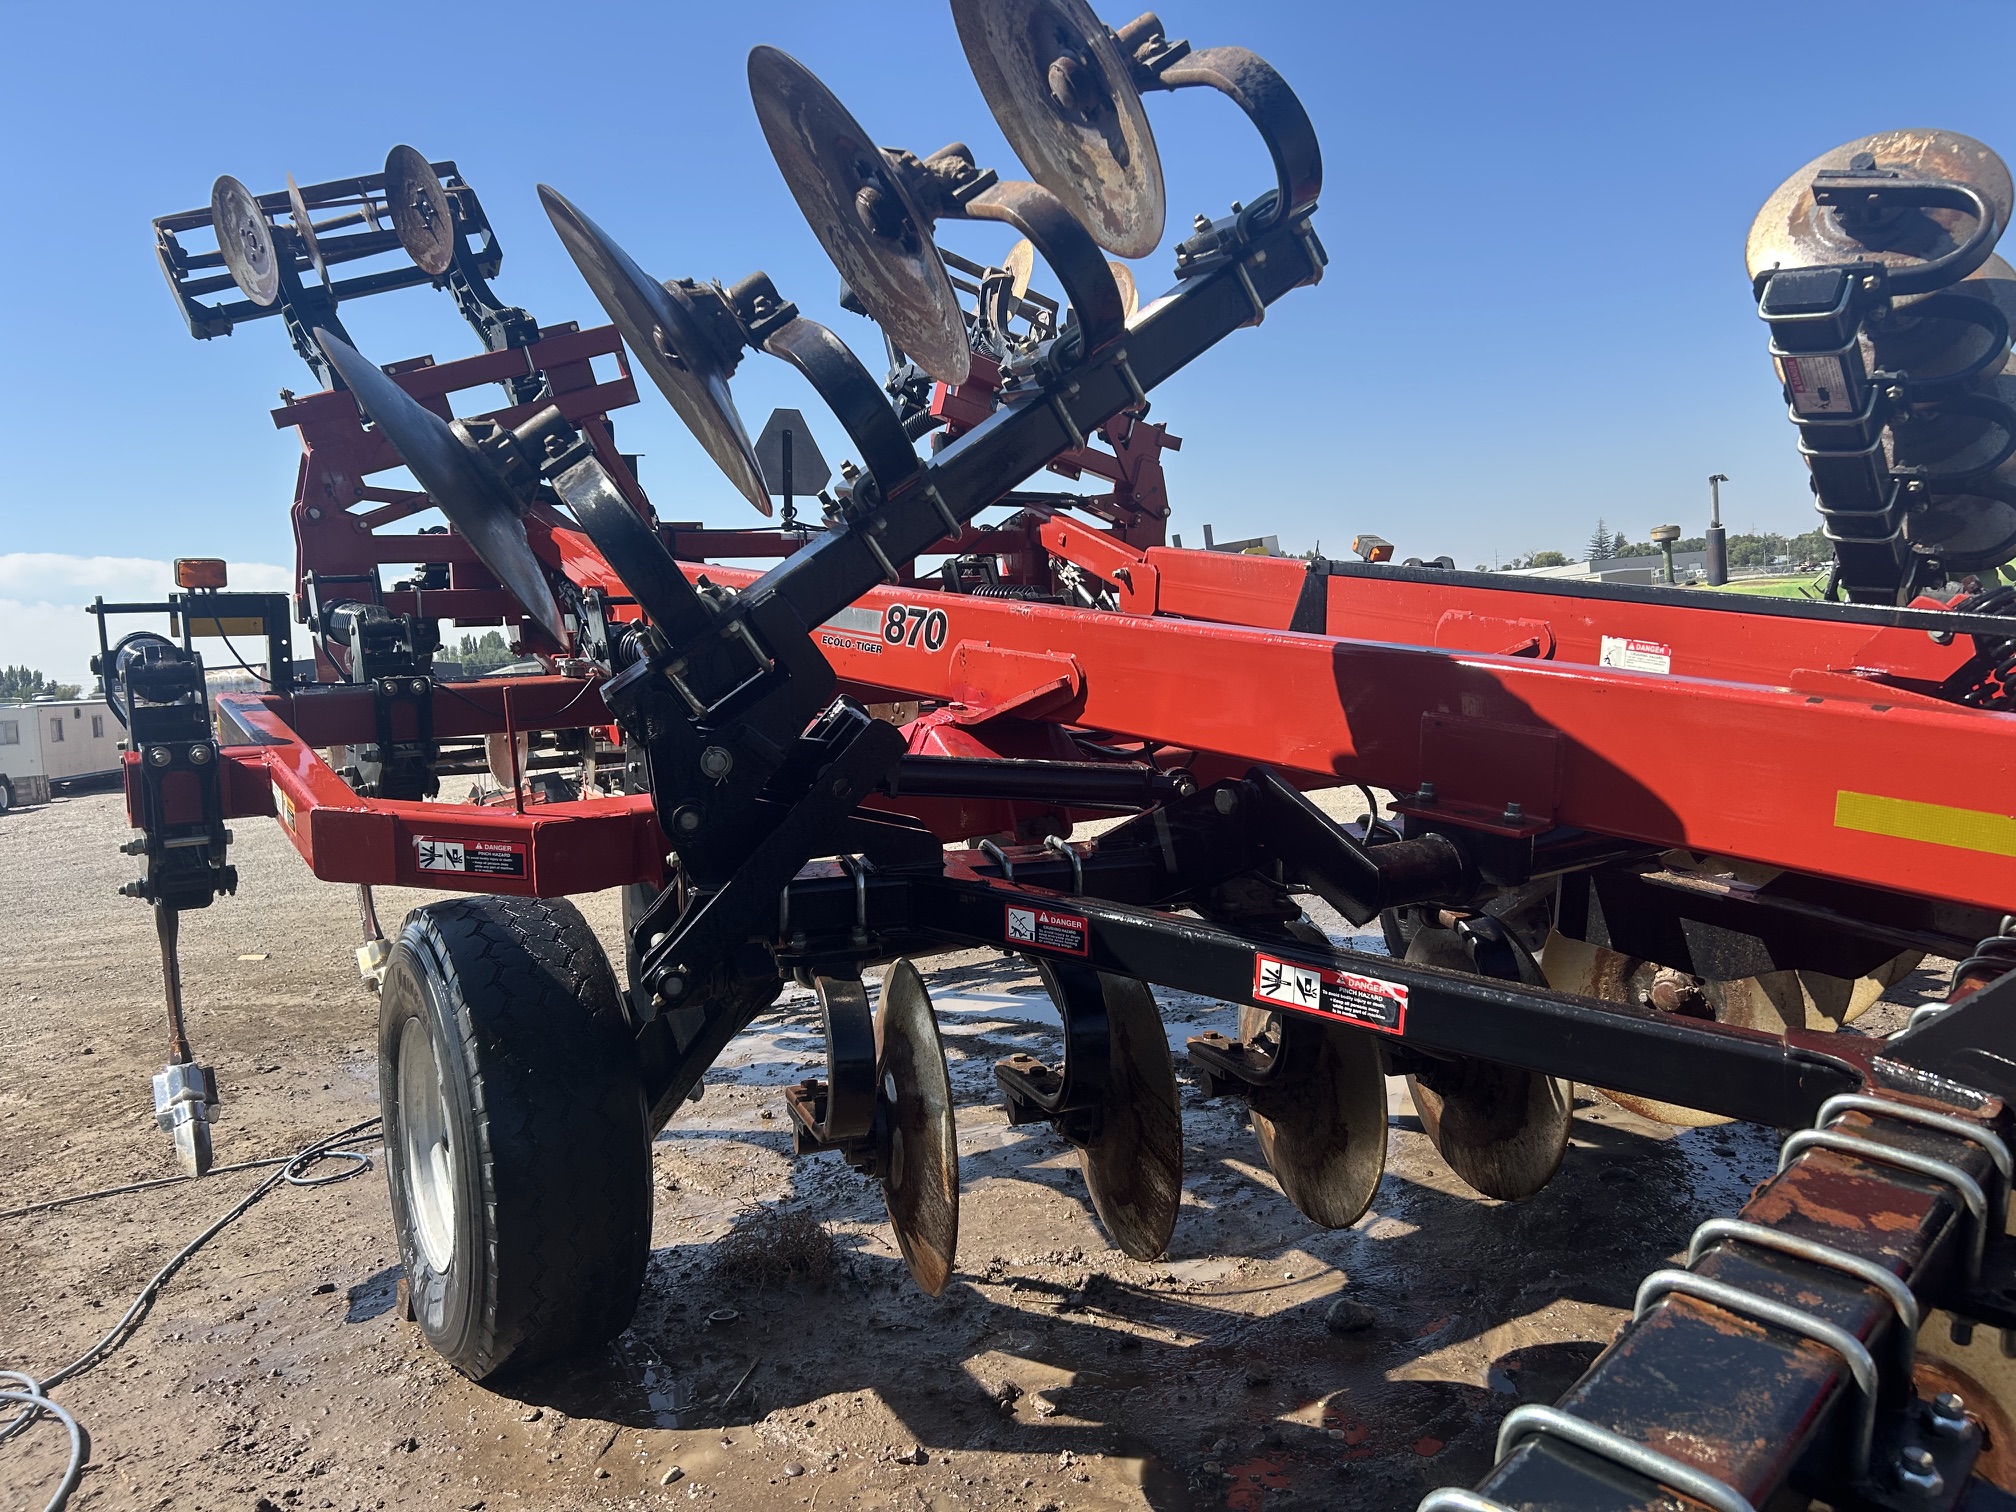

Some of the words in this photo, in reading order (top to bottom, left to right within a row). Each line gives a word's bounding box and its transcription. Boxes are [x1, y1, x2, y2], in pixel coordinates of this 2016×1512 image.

[1788, 361, 1802, 385] DANGER
[884, 603, 948, 652] 870
[1636, 644, 1664, 653] DANGER
[1051, 917, 1082, 929] DANGER
[1349, 979, 1386, 994] DANGER
[1339, 987, 1357, 995] PINCH
[1358, 992, 1383, 1002] HAZARD
